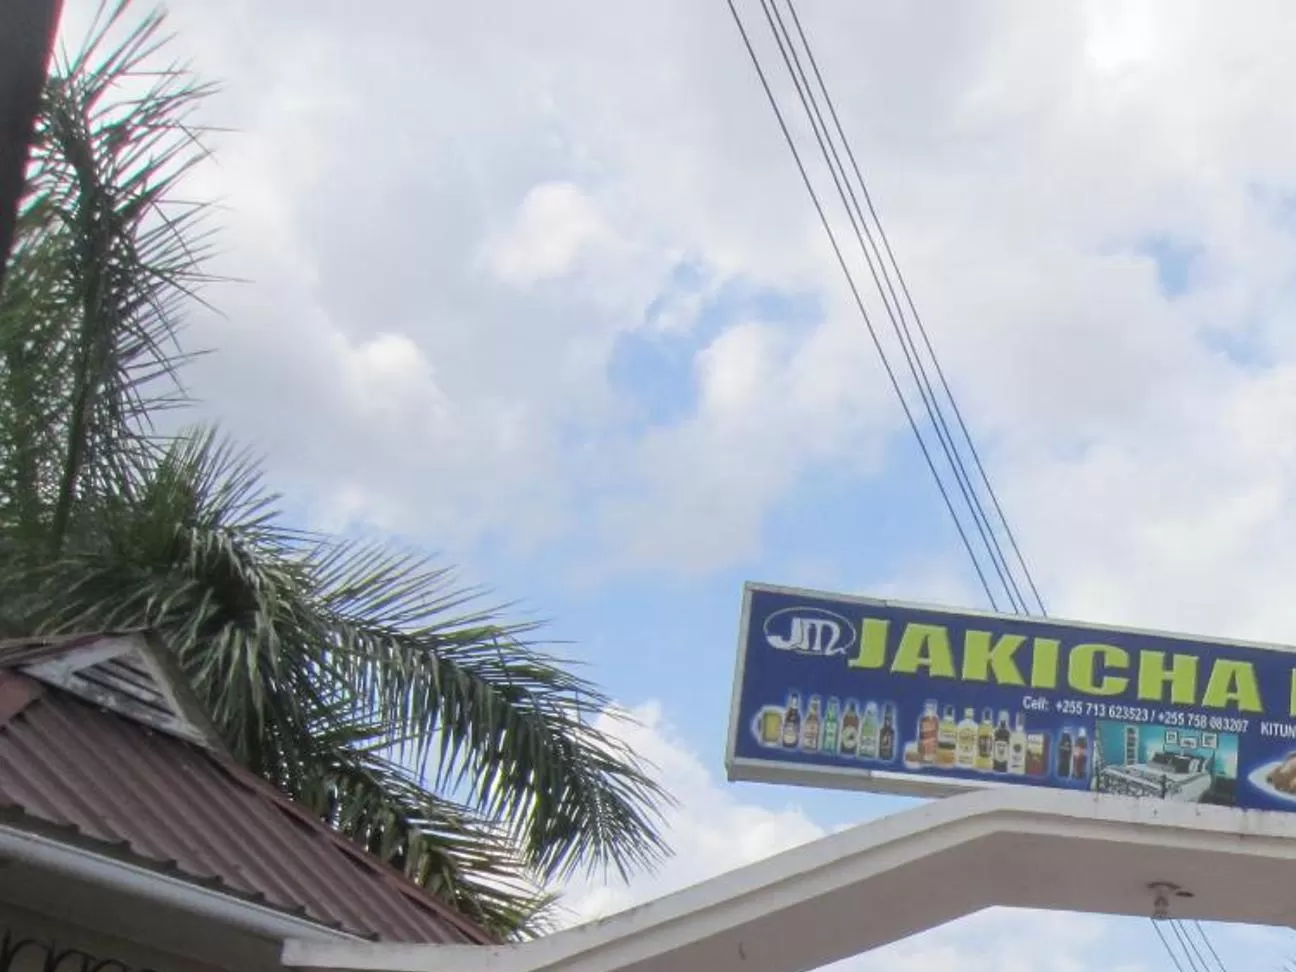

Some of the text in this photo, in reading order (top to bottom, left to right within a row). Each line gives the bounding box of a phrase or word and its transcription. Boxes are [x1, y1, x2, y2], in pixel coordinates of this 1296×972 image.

[847, 617, 1263, 713] JAKICHA
[1022, 695, 1049, 711] Cell:
[1056, 699, 1083, 715] +255
[1085, 702, 1106, 717] 713
[1158, 711, 1185, 726] +255
[1187, 713, 1207, 728] 758
